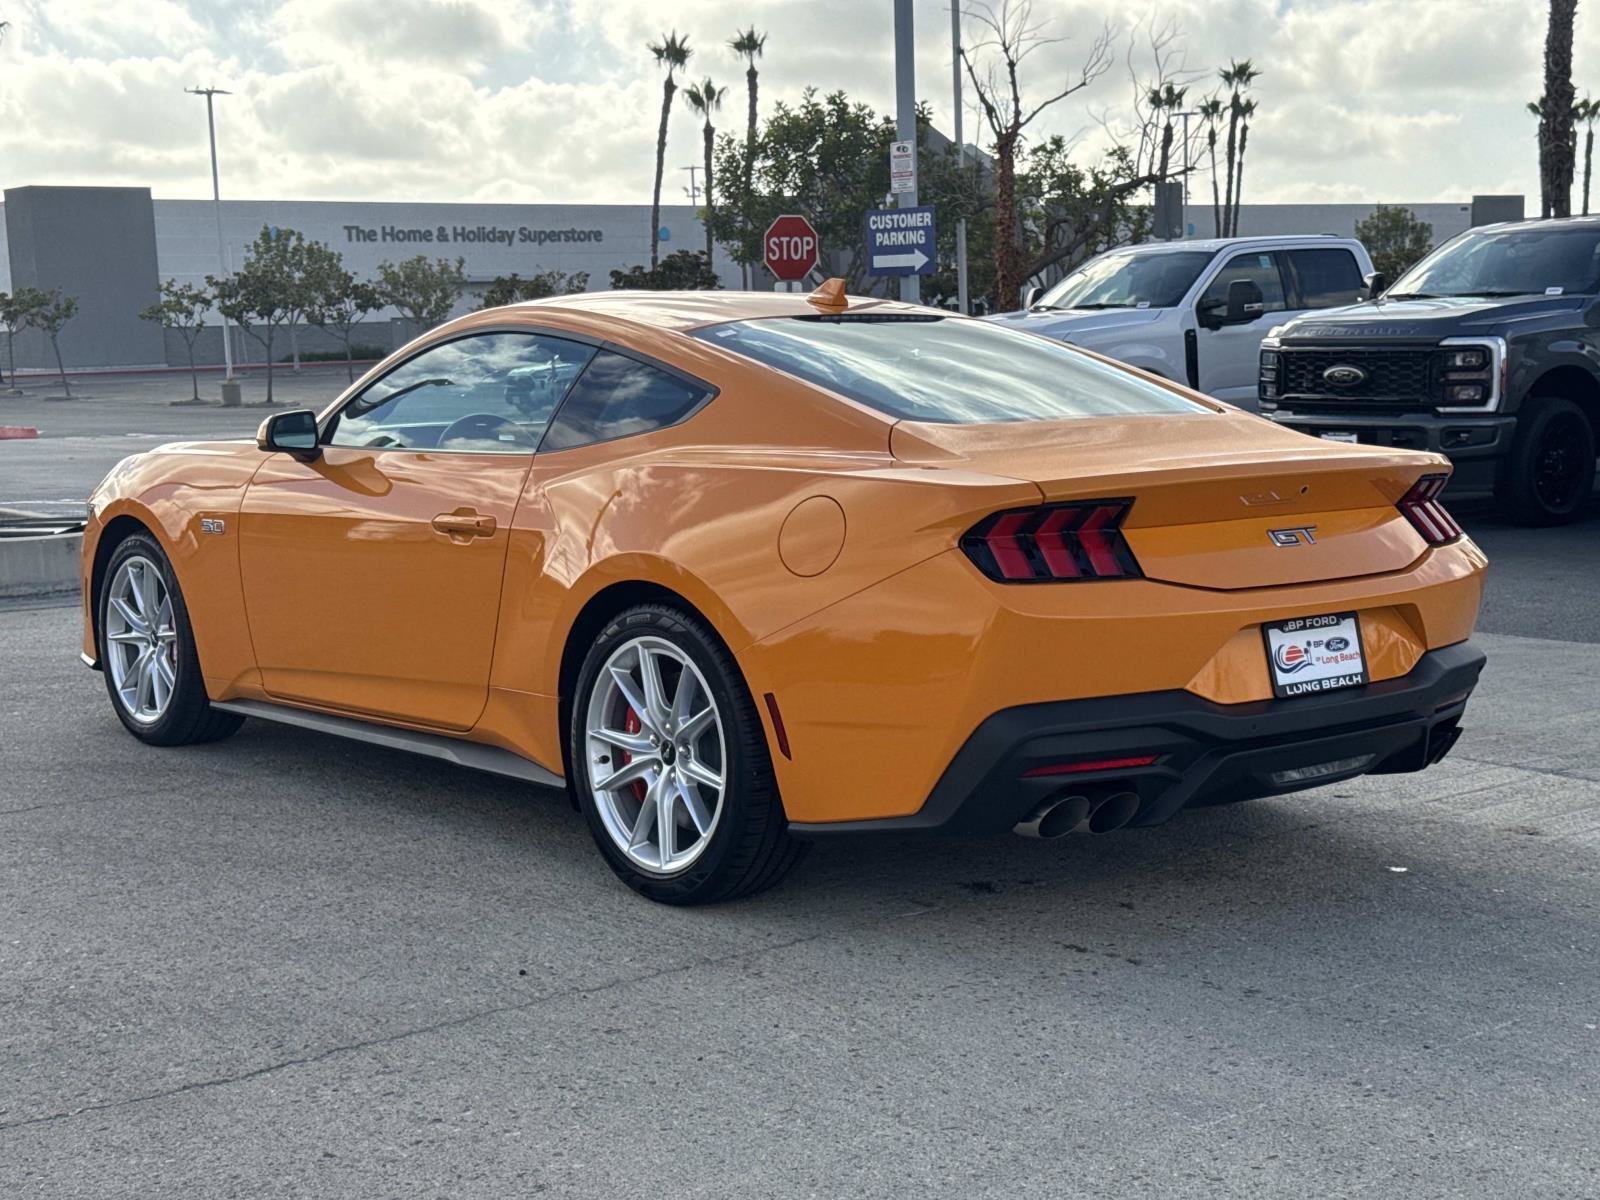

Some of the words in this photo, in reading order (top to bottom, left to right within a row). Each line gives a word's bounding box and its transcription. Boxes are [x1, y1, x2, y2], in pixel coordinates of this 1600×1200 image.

[869, 212, 932, 230] CUSTOMER
[343, 225, 378, 243] The
[381, 226, 434, 243] Home
[436, 226, 450, 243] &
[453, 226, 516, 247] Holiday
[518, 227, 603, 246] Superstore
[876, 230, 926, 247] PARKING
[768, 236, 814, 261] STOP
[1266, 524, 1318, 548] GT
[1288, 620, 1304, 630] BP
[1306, 616, 1337, 628] FORD
[1322, 656, 1340, 664] Long
[1340, 652, 1361, 662] Beach
[1286, 682, 1320, 695] LONG
[1321, 675, 1362, 689] BEACH
